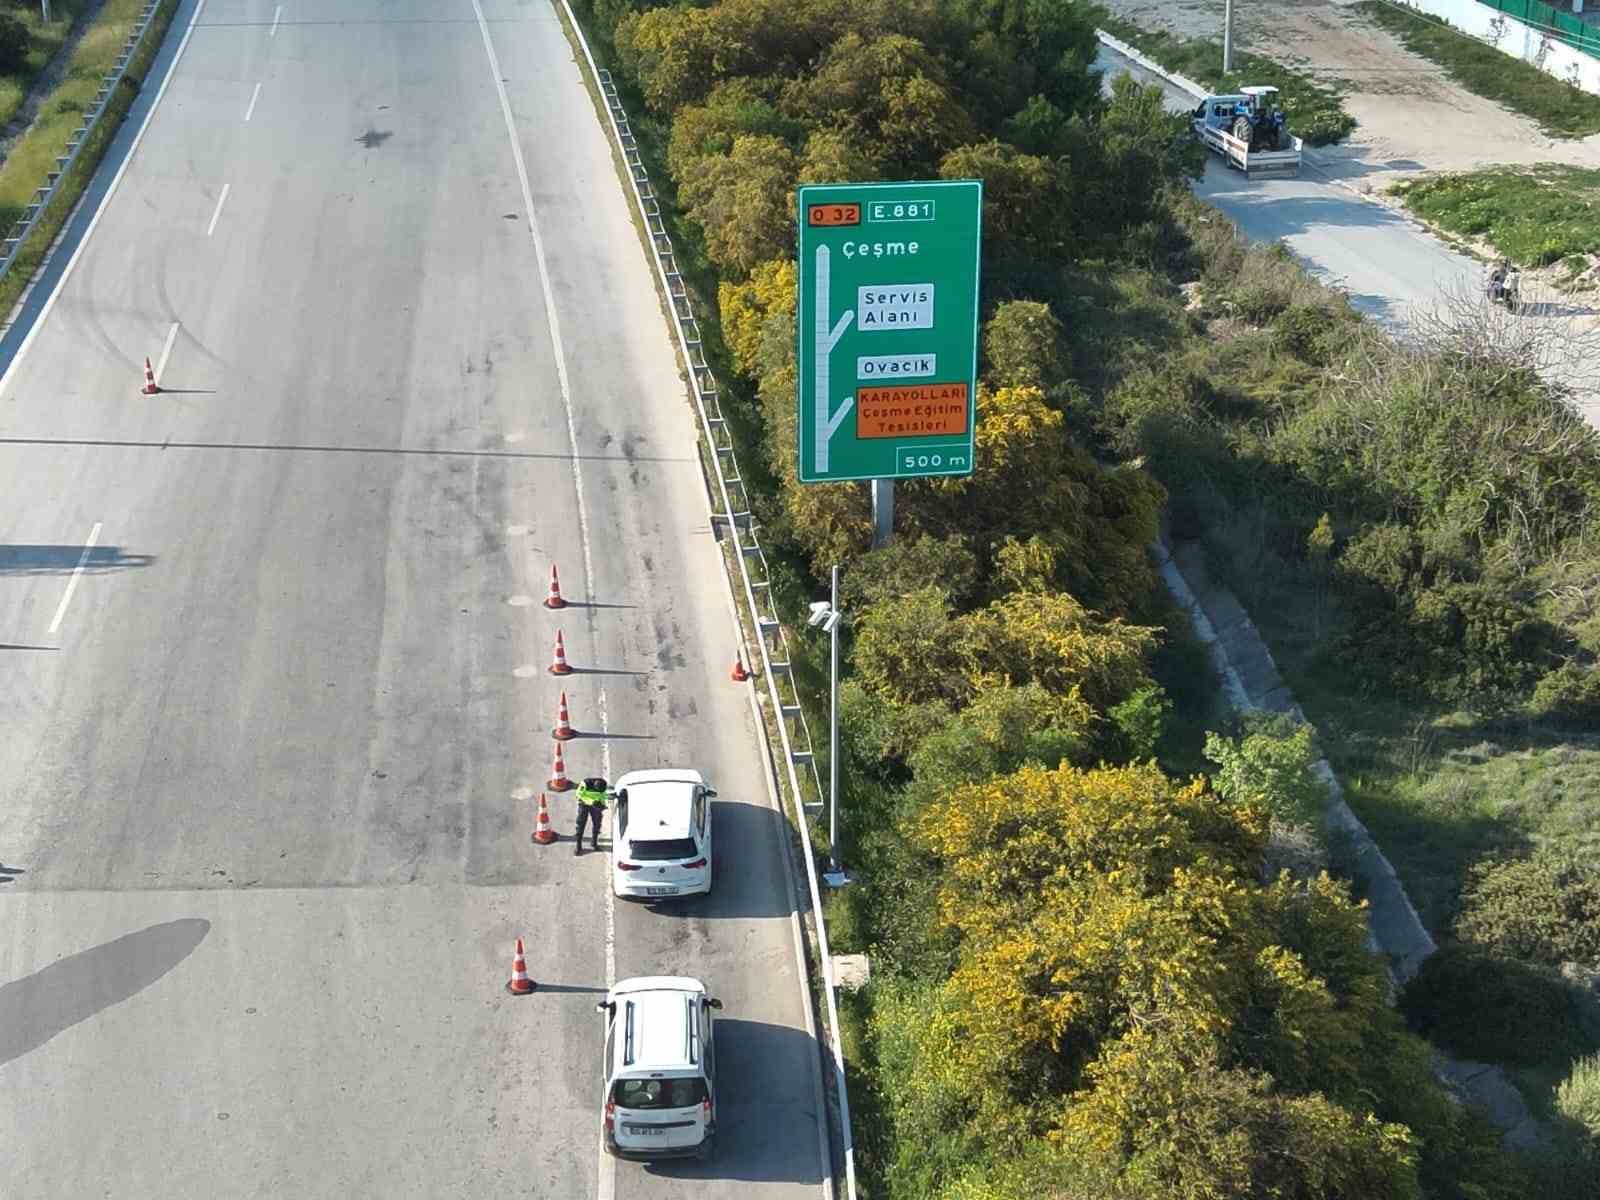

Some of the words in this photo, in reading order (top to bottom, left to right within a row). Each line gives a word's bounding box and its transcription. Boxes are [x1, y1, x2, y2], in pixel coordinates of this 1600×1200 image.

[874, 204, 929, 218] E.881
[842, 241, 919, 259] Çeşme
[864, 291, 928, 304] Servis
[904, 455, 942, 468] 500
[949, 456, 965, 466] m
